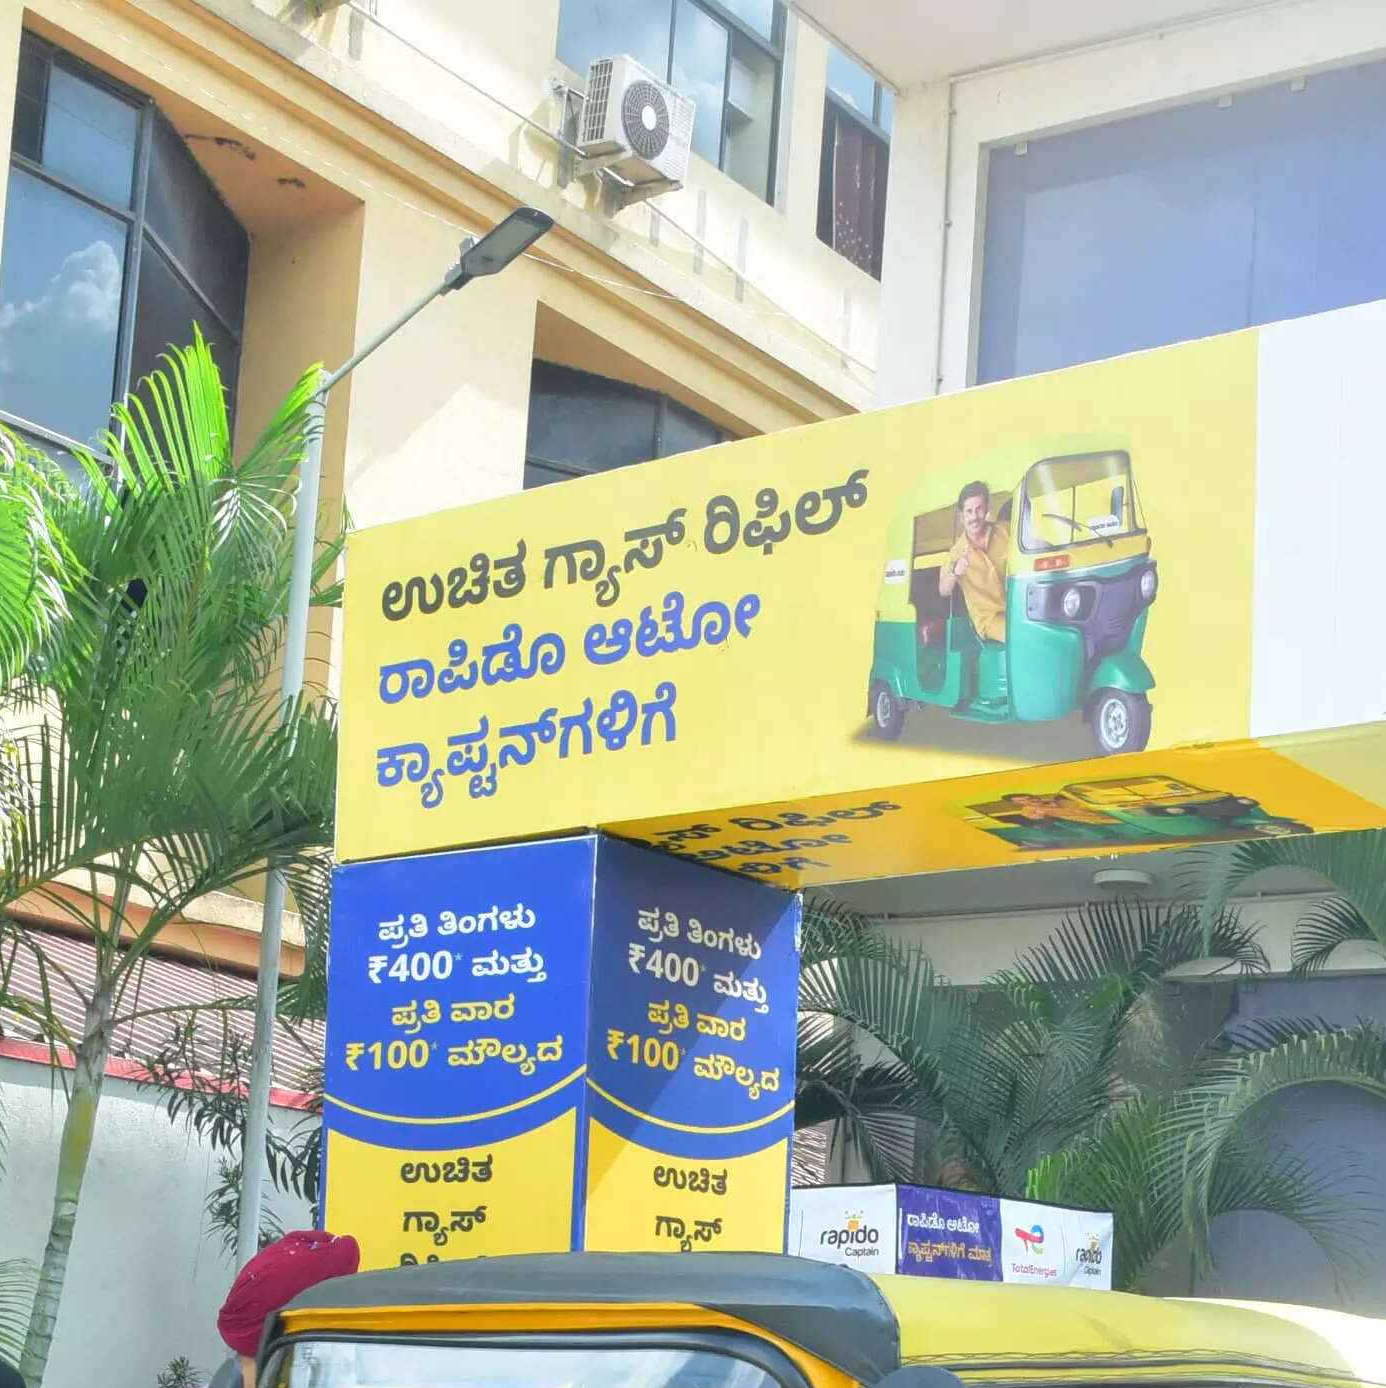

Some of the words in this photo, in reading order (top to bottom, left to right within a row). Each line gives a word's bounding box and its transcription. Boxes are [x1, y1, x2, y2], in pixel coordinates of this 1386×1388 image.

[382, 539, 526, 621] ಉಚಿತ
[544, 507, 687, 607] ಗ್ಯಾಸ್
[703, 469, 869, 555] ರಿಫಿಲ್
[379, 623, 565, 704] ರಾಪಿಡೊ
[584, 591, 761, 665] ಆಟೋ
[731, 801, 903, 831] ರಿಫಿಲ್
[379, 914, 427, 947] ಪ್ರತಿ
[438, 903, 536, 934] ತಿಂಗಳು
[637, 906, 679, 944] ಪ್ರತಿ
[686, 919, 762, 960] ತಿಂಗಳು
[471, 947, 547, 983] ಮತ್ತು
[391, 1001, 441, 1033] ಪ್ರತಿ
[450, 993, 515, 1022] ವಾರ
[712, 973, 769, 1013] ಮತ್ತು
[647, 1001, 689, 1038] ಪ್ರತಿ
[696, 1013, 746, 1042] ವಾರ
[448, 1036, 563, 1076] ಮೌಲ್ಯದ
[693, 1055, 779, 1101] ಮೌಲ್ಯದ
[400, 1154, 493, 1184] ಉಚಿತ
[653, 1165, 728, 1195] ಉಚಿತ
[402, 1205, 487, 1246] ಗ್ಯಾಸ್
[655, 1214, 723, 1252] ಗ್ಯಾಸ್
[820, 1226, 879, 1248] rapido
[845, 1247, 879, 1258] Captain
